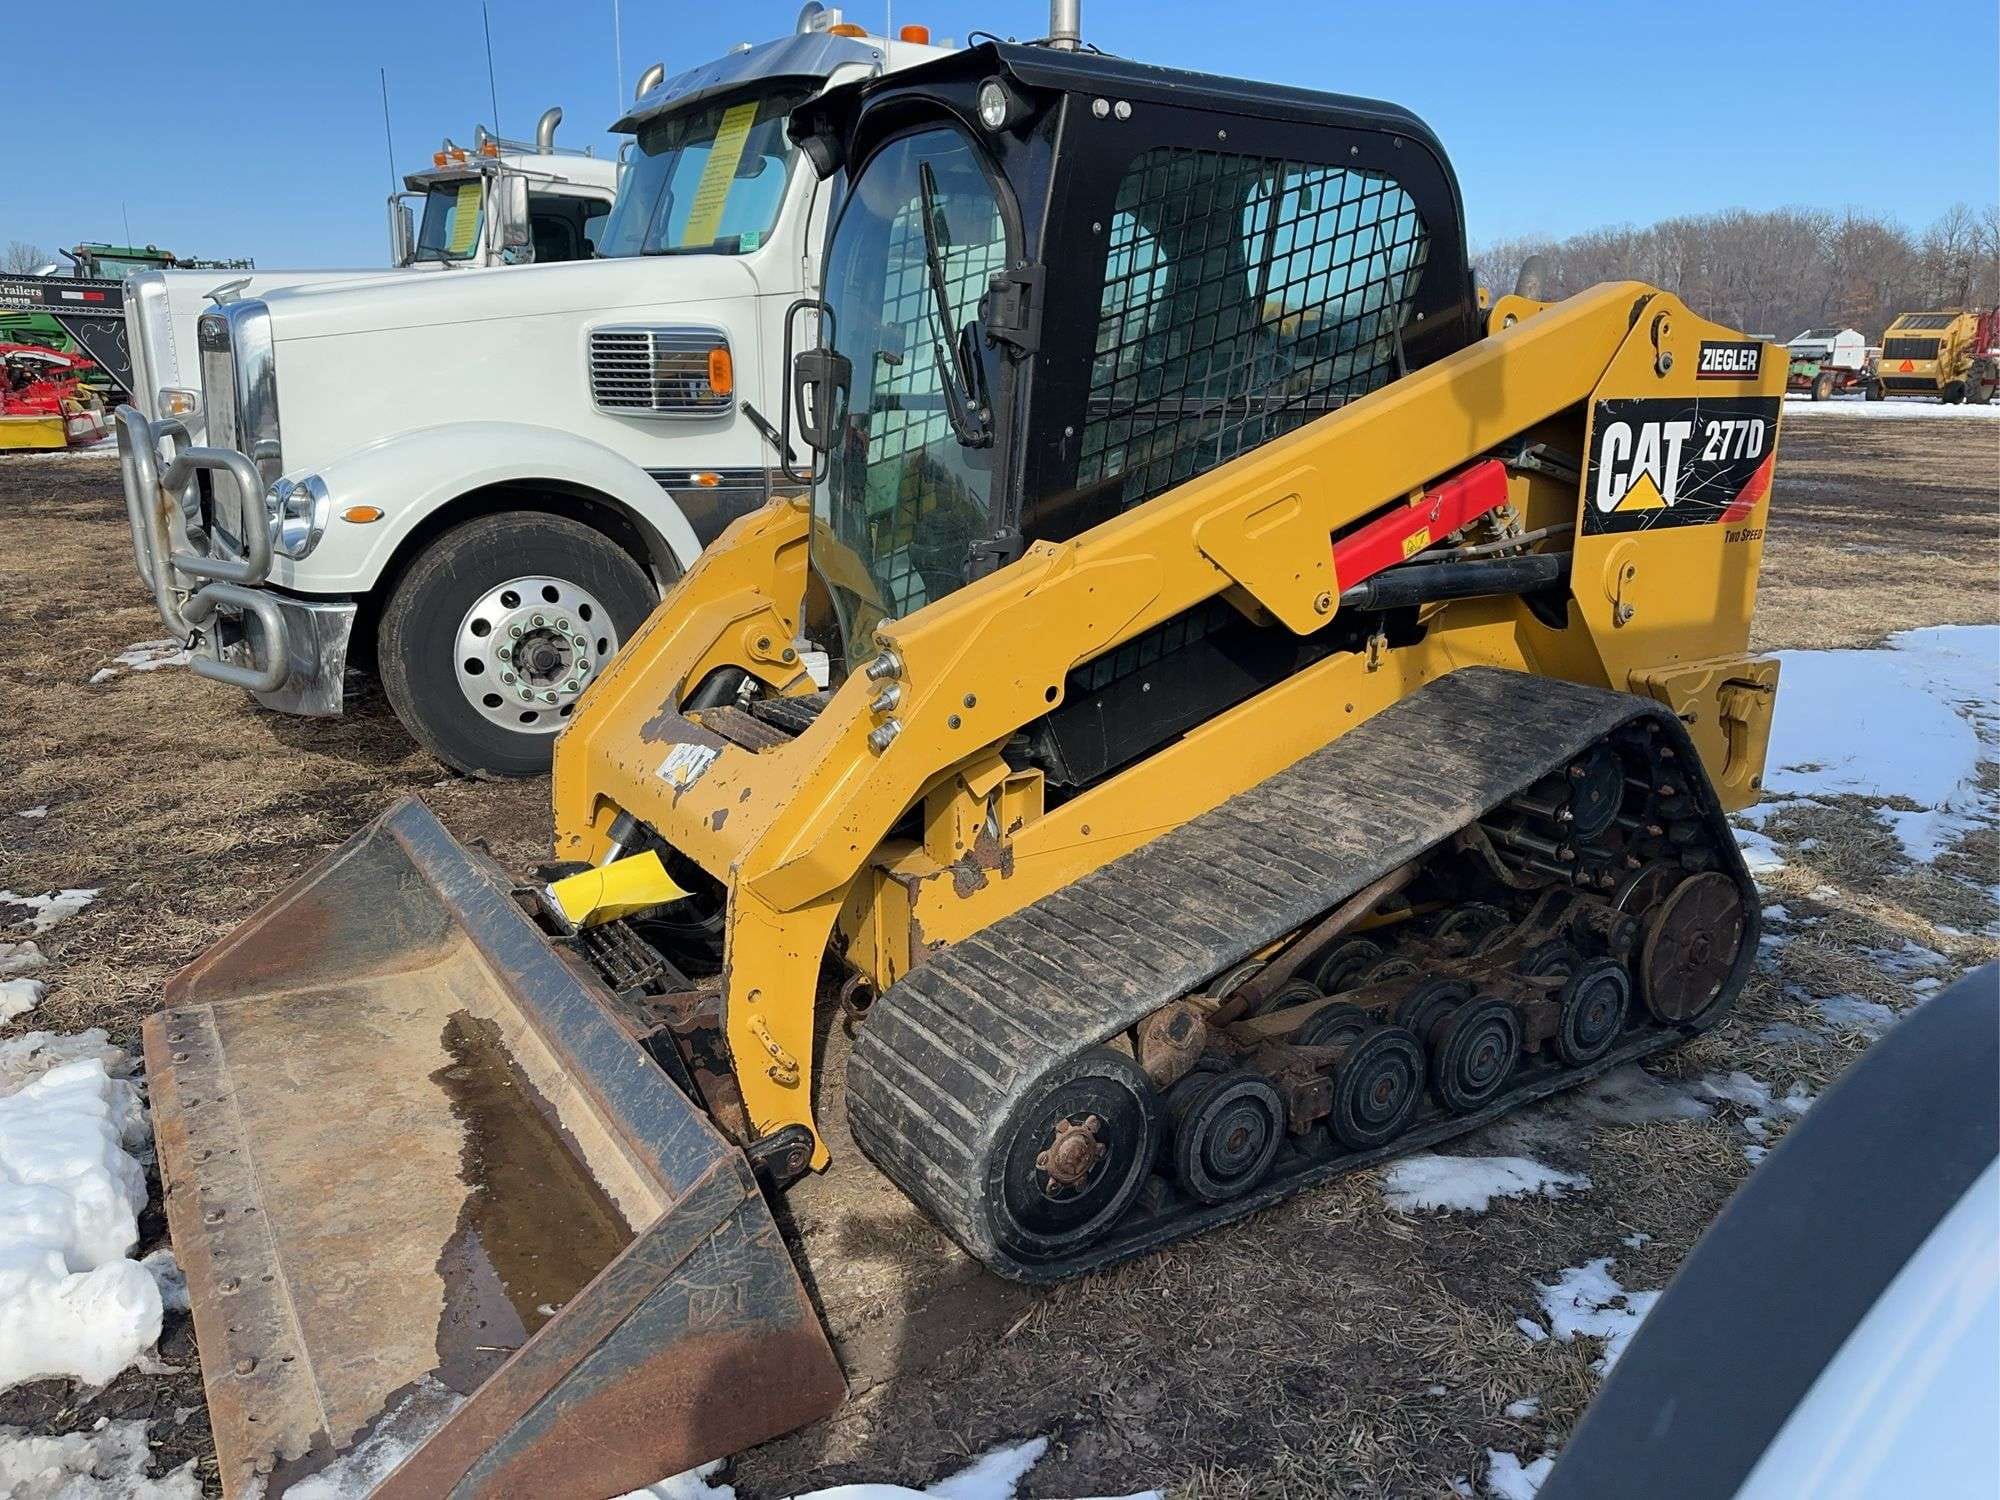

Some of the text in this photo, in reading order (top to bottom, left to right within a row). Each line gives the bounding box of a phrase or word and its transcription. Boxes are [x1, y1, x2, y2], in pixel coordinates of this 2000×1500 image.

[1700, 348, 1758, 371] ZIEGLER
[1596, 419, 1765, 513] CAT 277D
